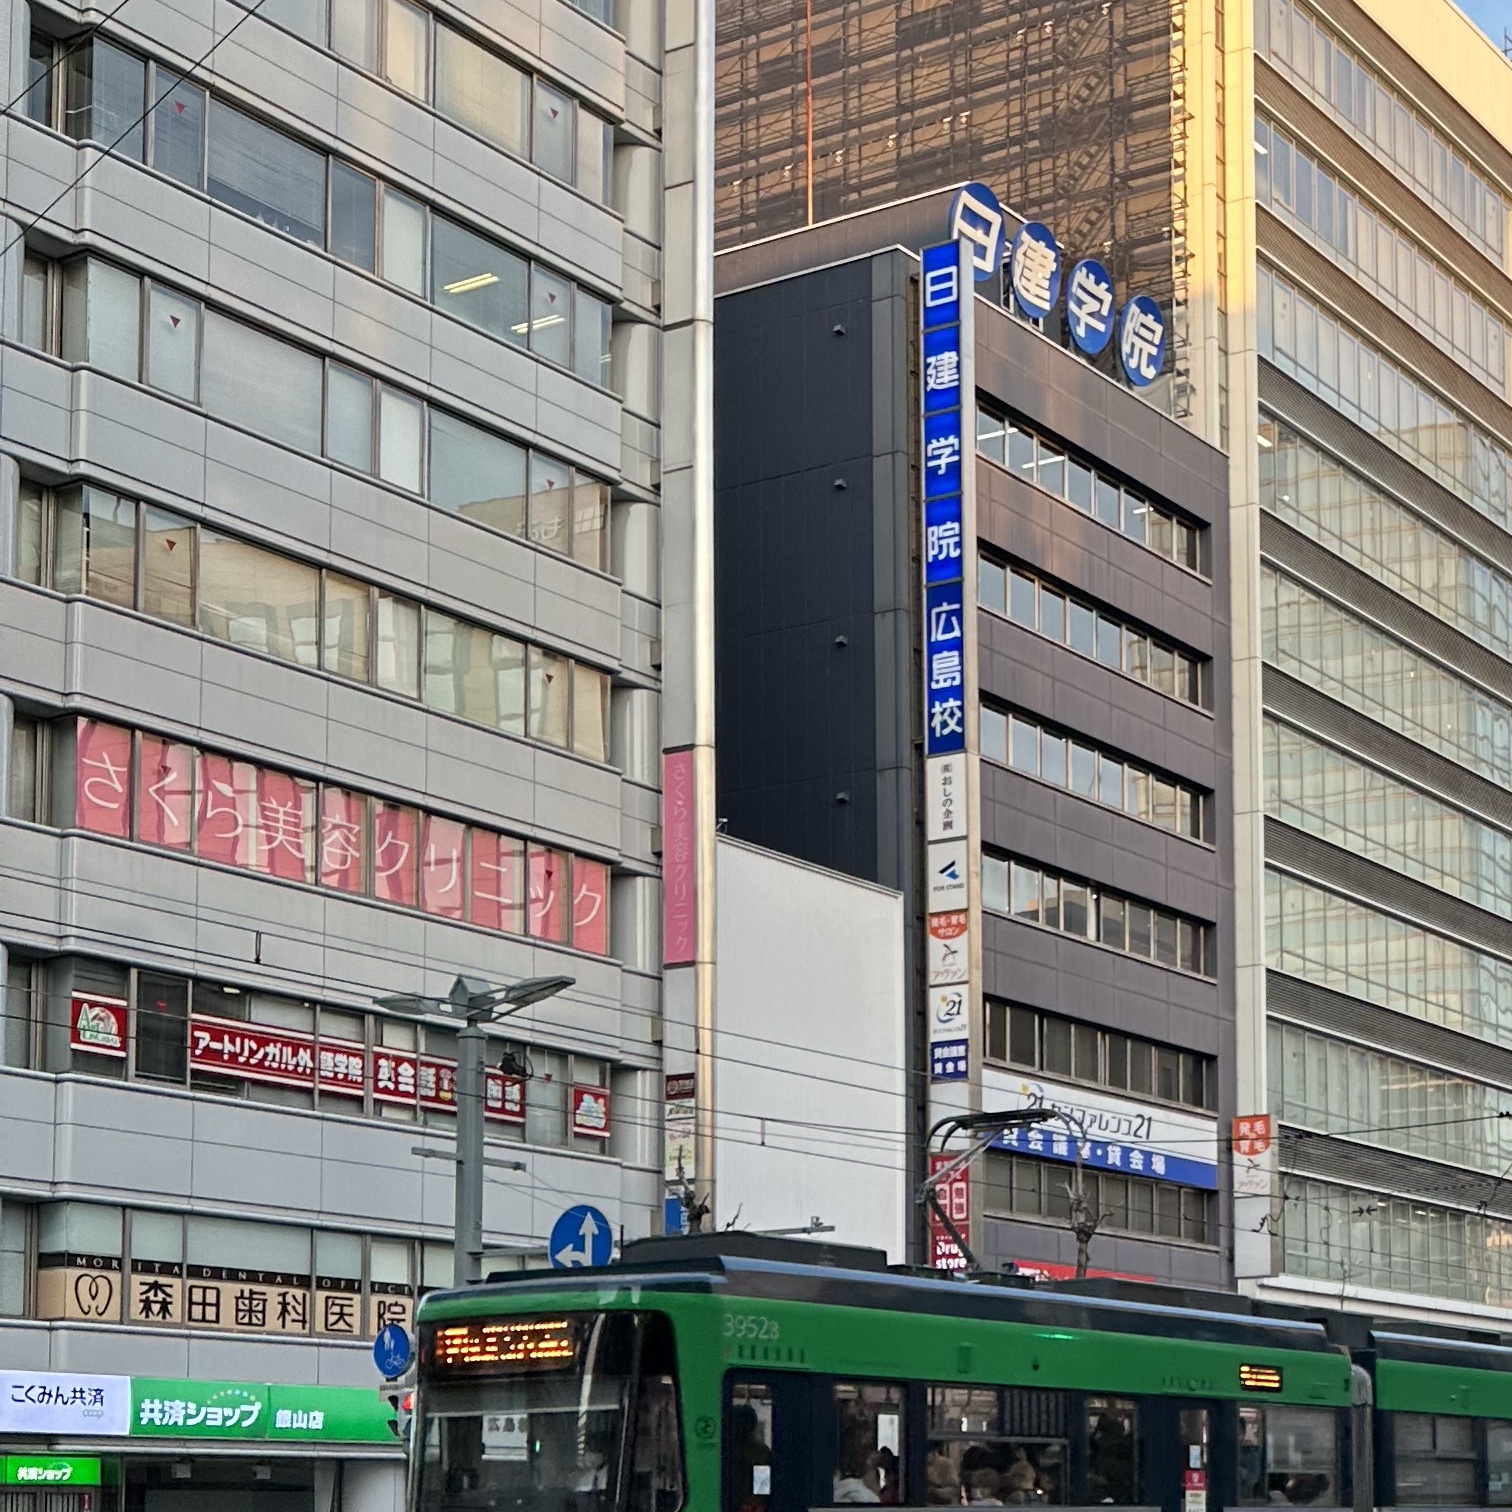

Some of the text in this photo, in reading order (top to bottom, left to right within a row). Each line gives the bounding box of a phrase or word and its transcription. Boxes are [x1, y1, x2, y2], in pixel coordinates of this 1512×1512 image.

[952, 189, 1163, 380] 日建学院
[81, 751, 602, 927] さくら美容クリニック
[672, 761, 689, 954] さくら美容クリニック
[944, 998, 962, 1016] 21
[192, 1030, 364, 1083] アートリンガル外語学院
[75, 1256, 181, 1276] MORITA
[202, 1267, 301, 1287] DENTAL
[935, 1257, 967, 1270] store
[138, 1280, 407, 1334] 森田歯科医院
[723, 1314, 779, 1340] 3952B
[11, 1384, 105, 1407] こくみん共済
[139, 1398, 262, 1428] 共済ショップ
[17, 1466, 72, 1481] 共済ショップ
